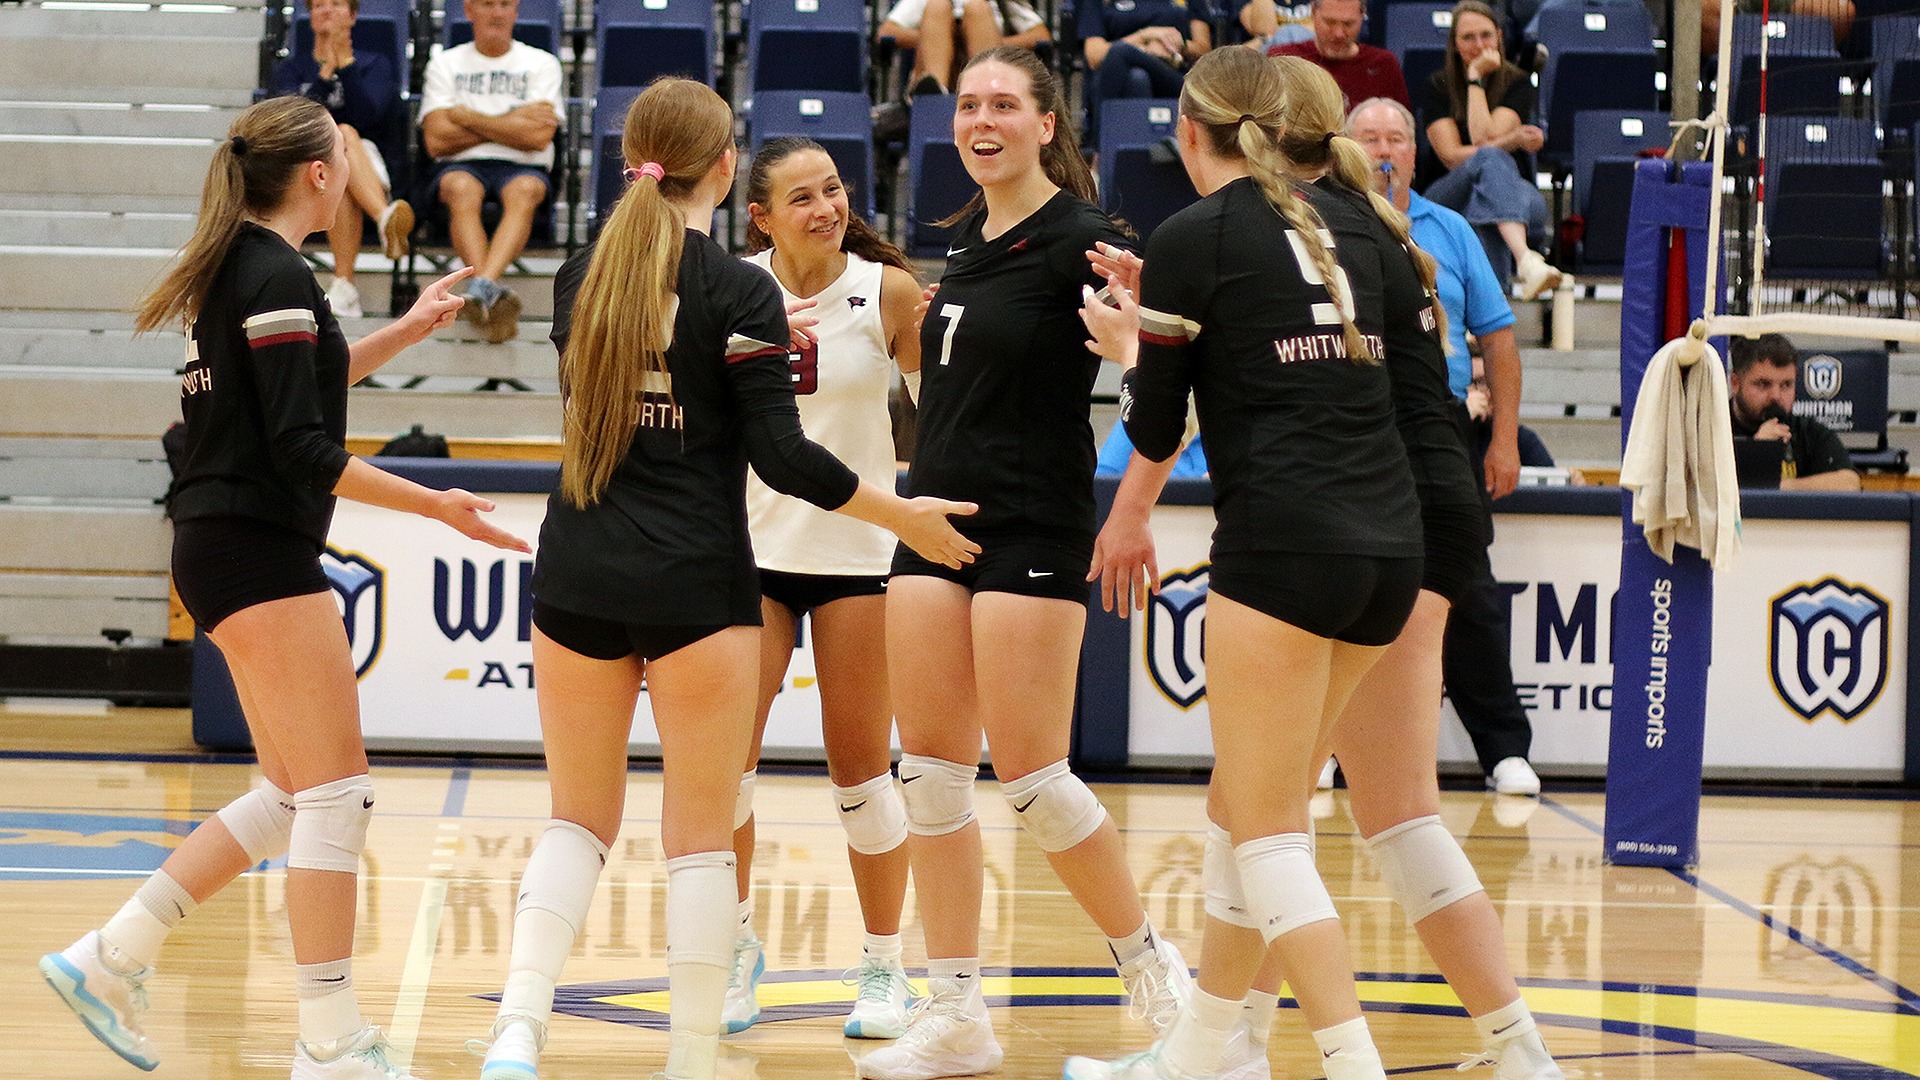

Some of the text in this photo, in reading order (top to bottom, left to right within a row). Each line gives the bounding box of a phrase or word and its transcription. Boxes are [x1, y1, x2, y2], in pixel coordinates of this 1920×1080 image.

[1284, 228, 1356, 325] 5
[939, 302, 966, 366] 7
[1274, 334, 1385, 364] WHITWTH
[1645, 577, 1673, 750] sports imports
